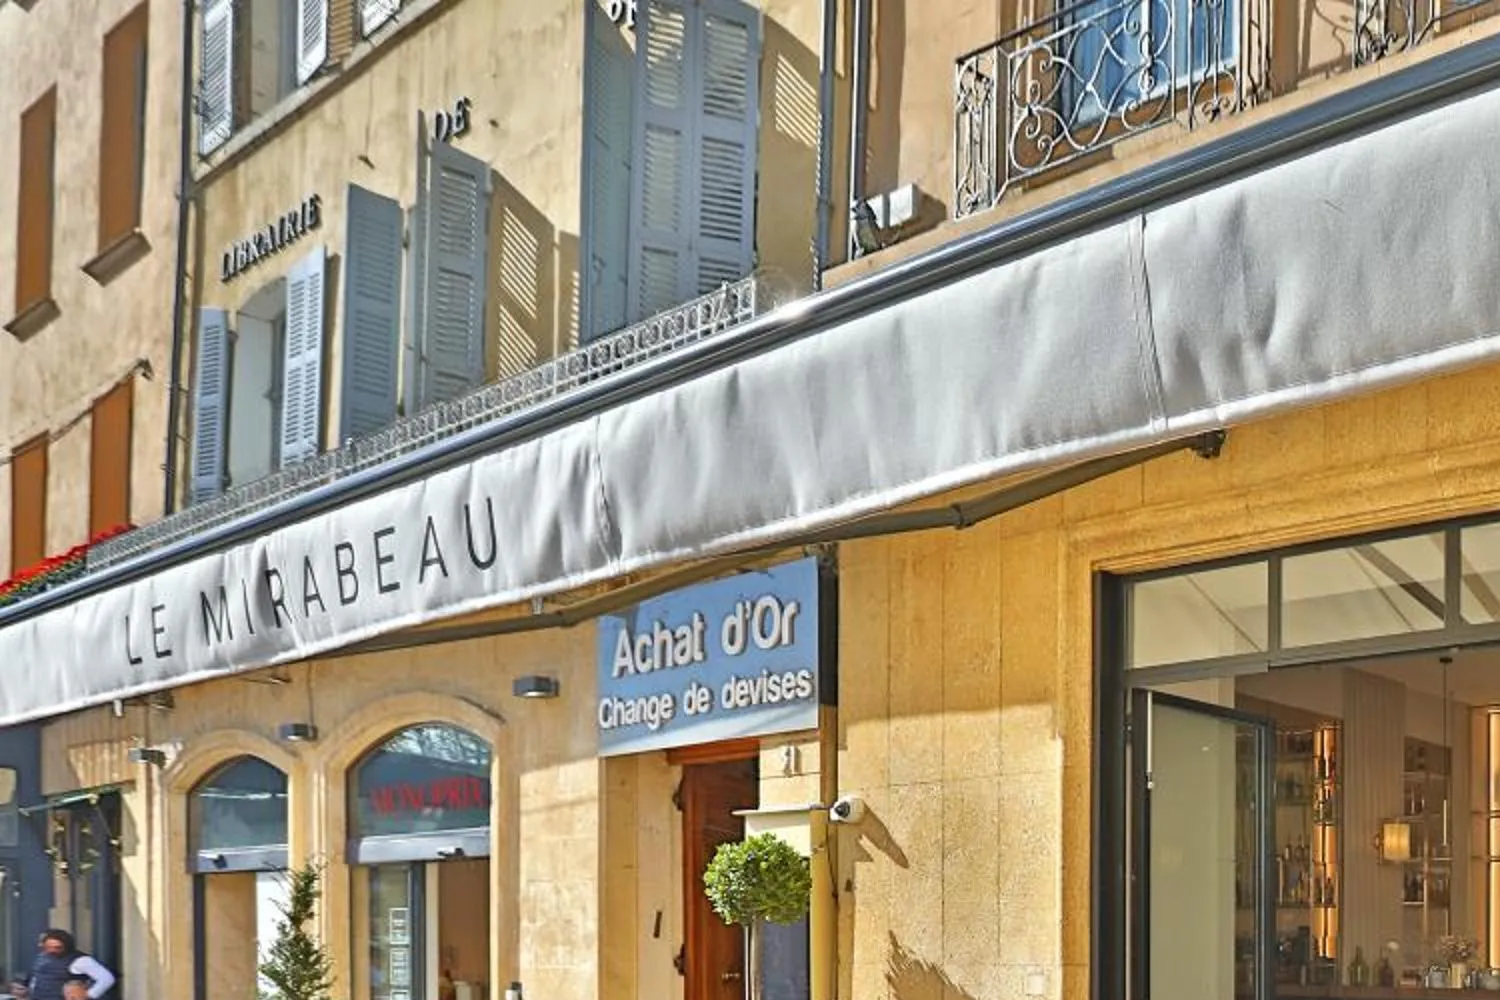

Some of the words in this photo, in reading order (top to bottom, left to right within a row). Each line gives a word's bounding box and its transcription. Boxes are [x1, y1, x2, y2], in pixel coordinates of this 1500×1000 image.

[222, 191, 322, 283] LIBRAIRIE
[433, 96, 471, 140] DE
[125, 603, 172, 665] LE
[200, 496, 498, 647] MIRABEAU
[612, 611, 706, 679] Achat
[721, 594, 800, 656] d'Or
[598, 691, 675, 730] Change
[683, 681, 711, 716] de
[721, 668, 813, 710] devises
